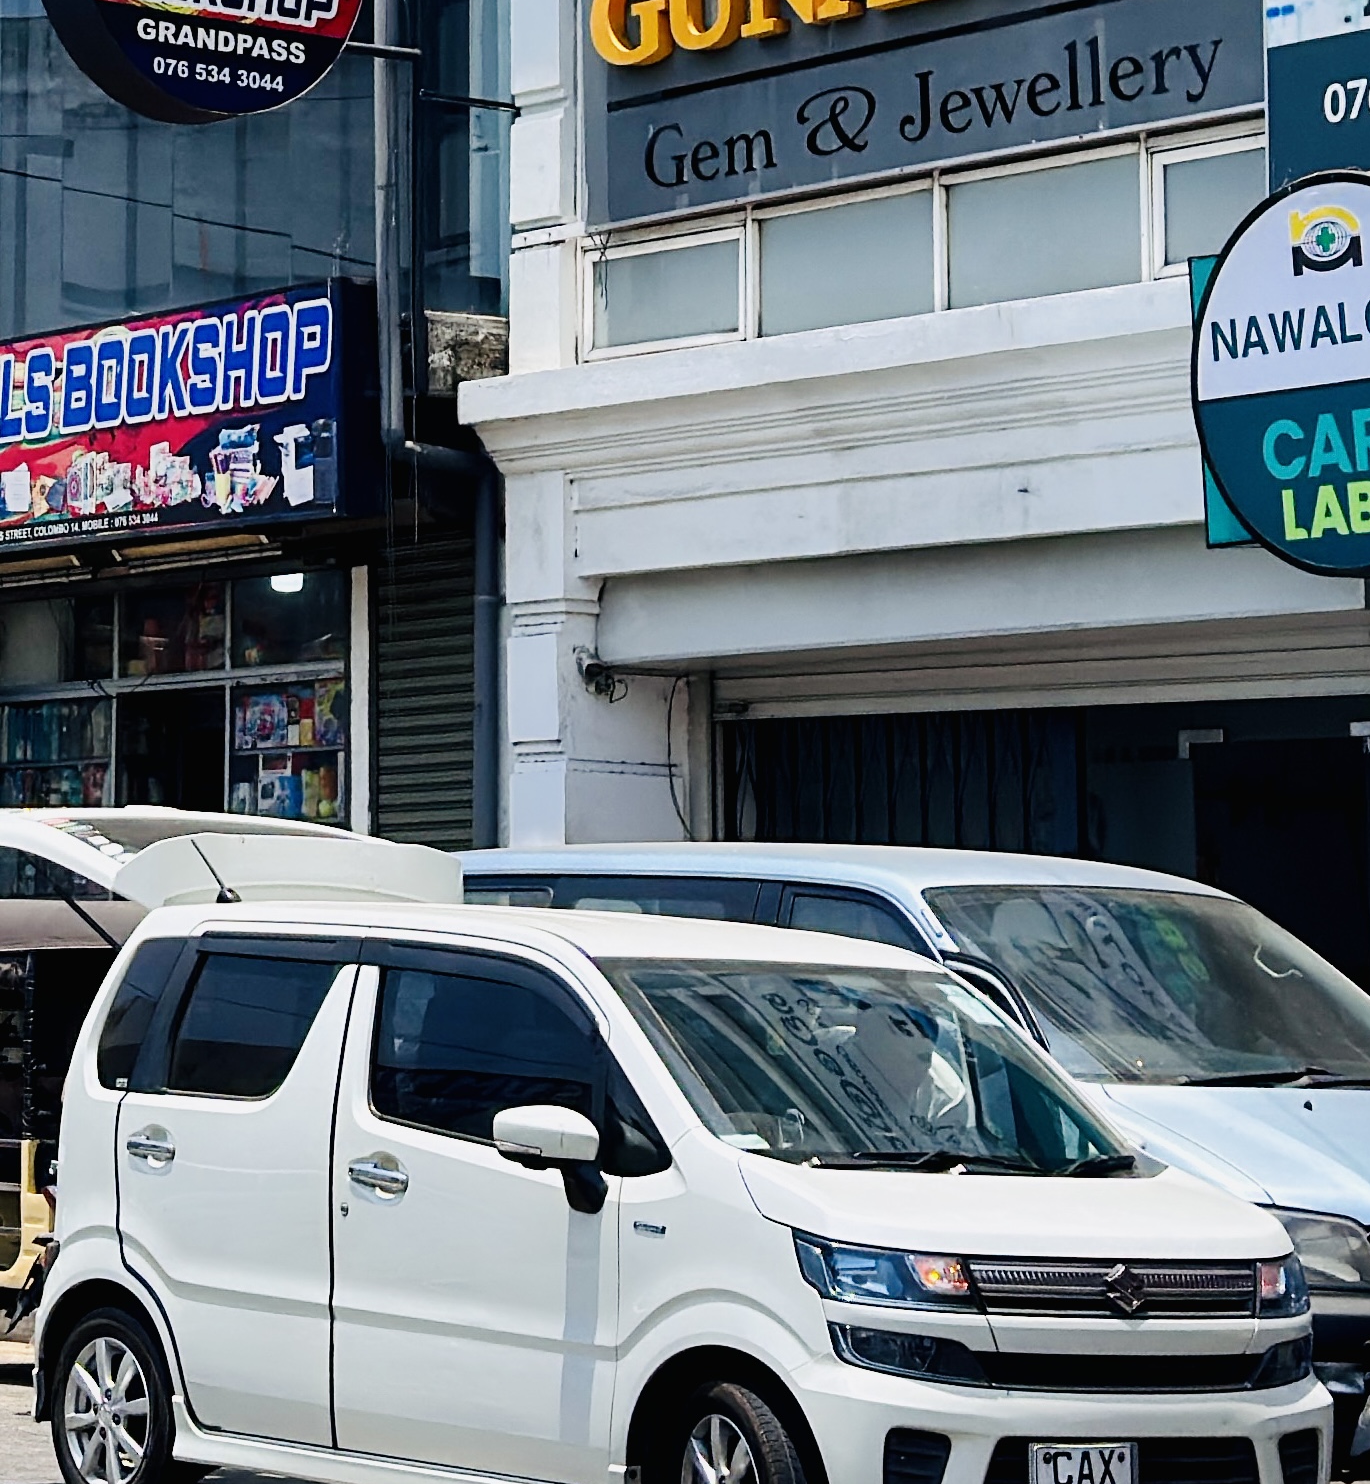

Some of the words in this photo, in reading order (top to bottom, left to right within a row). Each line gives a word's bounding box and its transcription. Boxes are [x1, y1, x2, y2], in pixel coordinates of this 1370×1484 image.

[137, 18, 306, 64] GRANDPASS
[153, 56, 189, 78] 076
[195, 63, 231, 84] 534
[236, 69, 284, 92] 3044
[643, 123, 777, 189] Gem
[796, 83, 876, 156] &
[899, 36, 1223, 144] Jewellery
[60, 298, 332, 434] BOOKSHOP
[34, 520, 69, 538] COLOMBO
[82, 516, 109, 532] MOBILE
